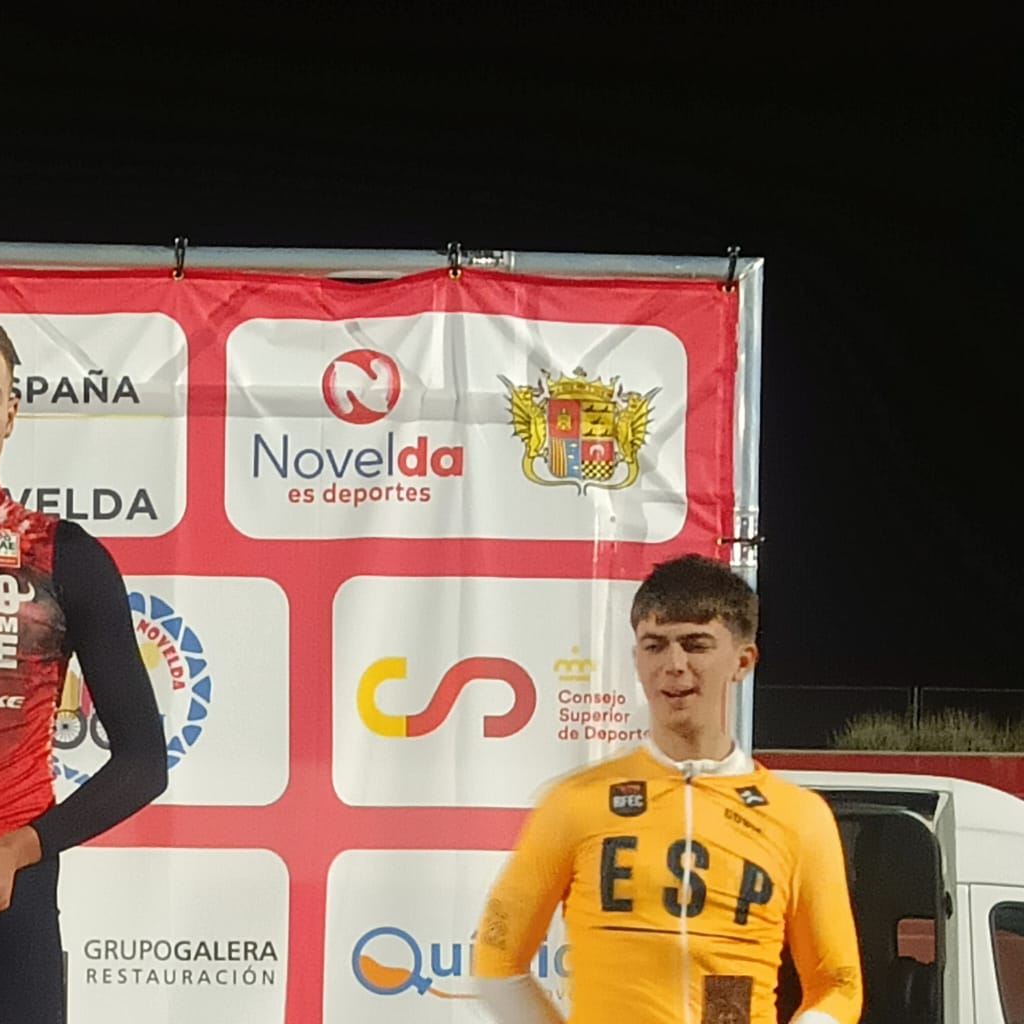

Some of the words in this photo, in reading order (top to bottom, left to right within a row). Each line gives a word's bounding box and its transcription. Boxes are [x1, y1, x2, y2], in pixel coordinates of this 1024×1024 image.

[252, 431, 464, 479] Novelda
[5, 487, 157, 520] VELDA
[288, 485, 314, 503] es
[323, 482, 431, 508] deportes
[137, 619, 185, 691] NOVELDA
[558, 689, 626, 707] Consejo
[559, 706, 630, 724] Superior
[558, 725, 579, 740] de
[600, 836, 773, 925] ESP
[84, 939, 278, 962] GRUPOGALERA
[86, 964, 275, 985] RESTAURACIÓN
